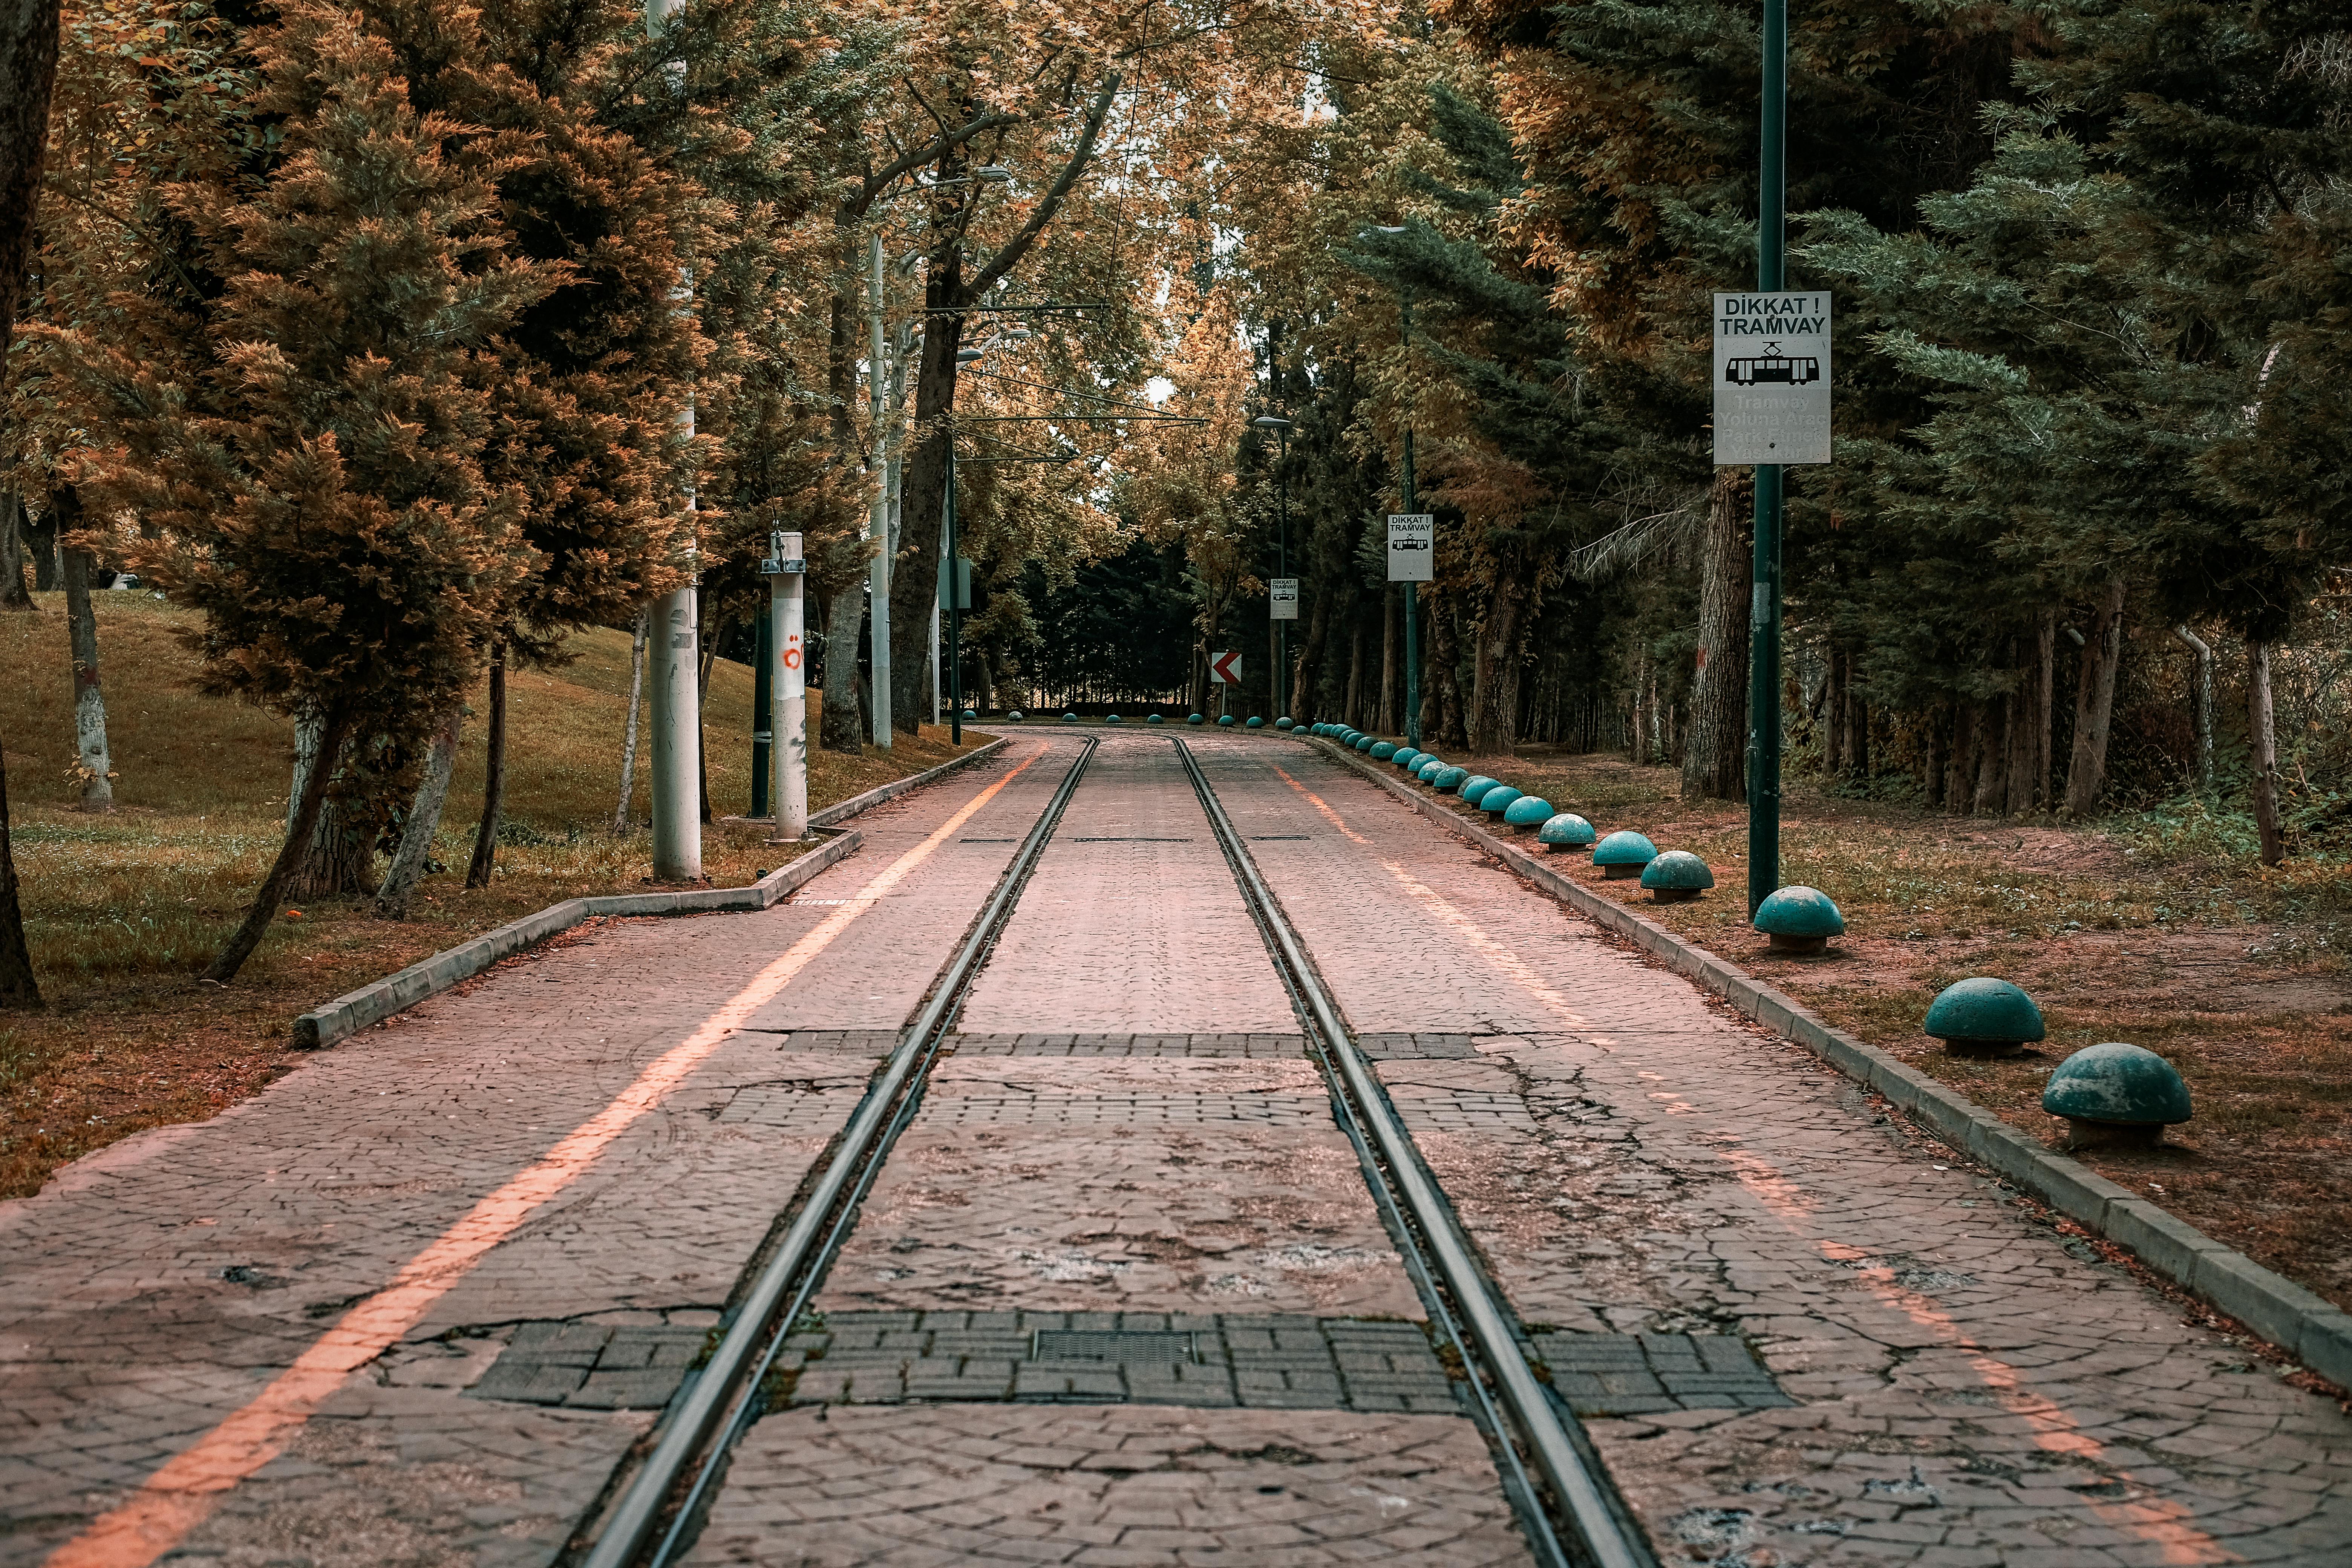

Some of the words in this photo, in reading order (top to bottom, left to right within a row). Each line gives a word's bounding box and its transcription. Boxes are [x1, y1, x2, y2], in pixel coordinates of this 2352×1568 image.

[1726, 294, 1807, 315] DİKKAT
[1815, 297, 1819, 314] !
[1720, 317, 1826, 335] TRAMVAY
[1734, 395, 1808, 411] Tramvay
